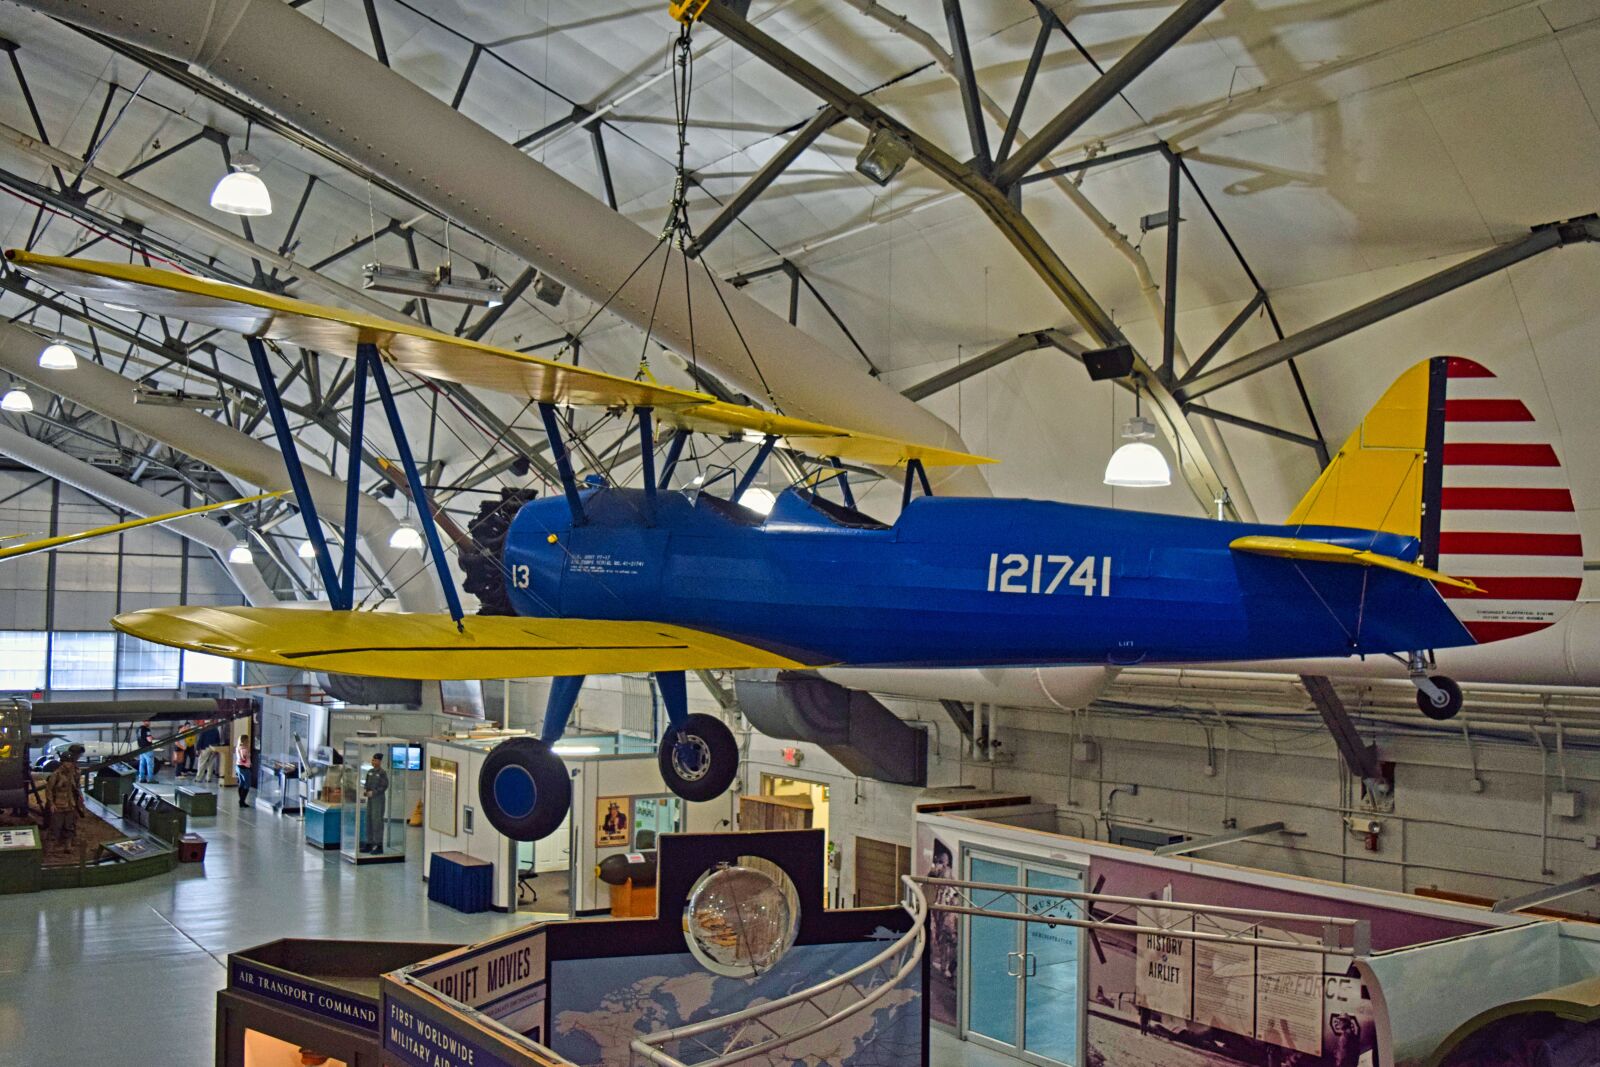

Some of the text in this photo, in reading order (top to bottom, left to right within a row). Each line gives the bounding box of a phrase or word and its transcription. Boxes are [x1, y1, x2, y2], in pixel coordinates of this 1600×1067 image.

[512, 564, 530, 589] 13
[987, 553, 1111, 597] 121741
[1147, 933, 1183, 956] HISTORY
[433, 947, 531, 1003] IRLIFT MOVIES
[1148, 961, 1180, 984] AIRLIFT
[239, 971, 376, 1023] AIR TRANSPORT COMMAND
[391, 1004, 474, 1065] FIRST WORLDWIDE
[391, 1027, 431, 1063] MILITARY
